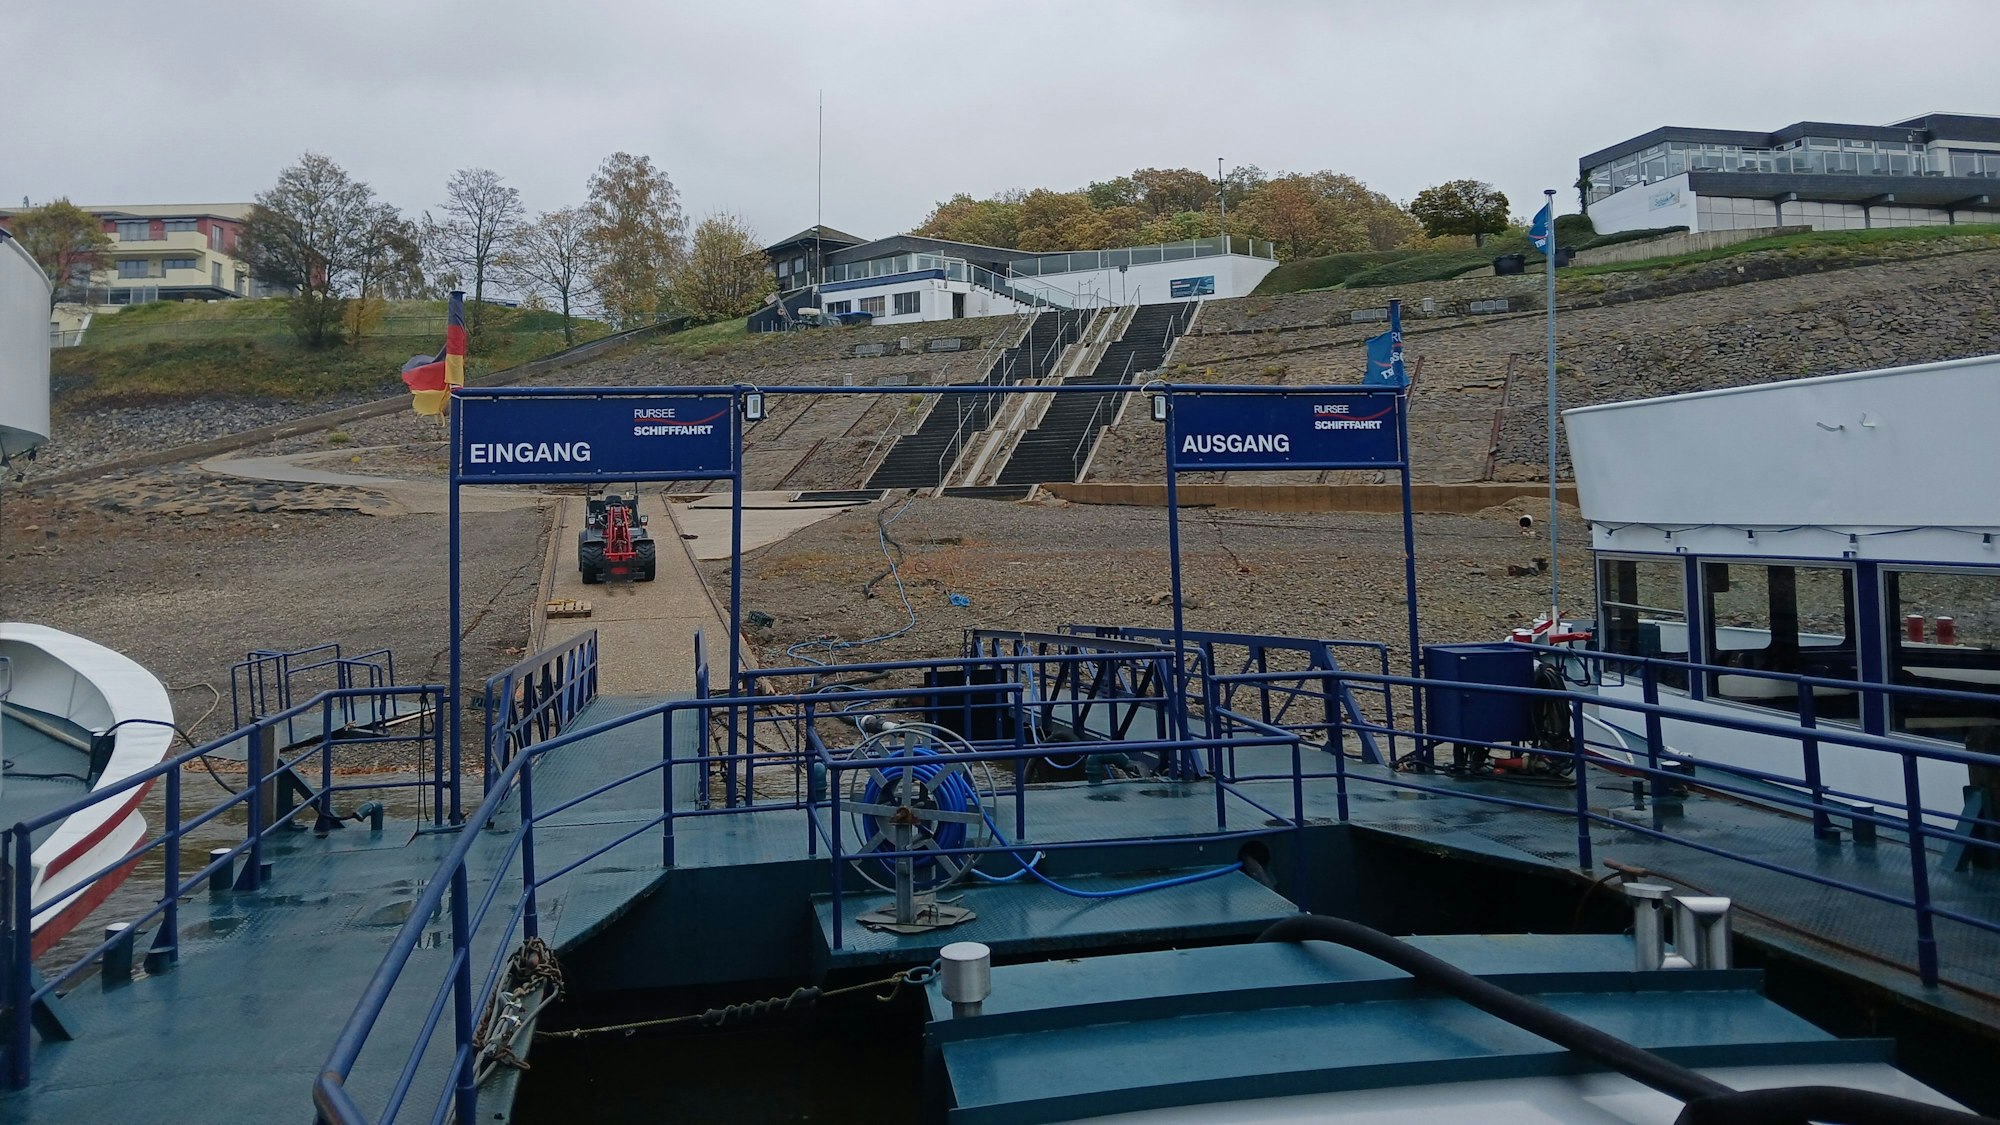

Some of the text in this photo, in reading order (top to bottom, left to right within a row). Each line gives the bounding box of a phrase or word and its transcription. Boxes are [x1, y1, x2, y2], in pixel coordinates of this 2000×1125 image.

[634, 408, 675, 419] RURSEE
[1314, 404, 1350, 414] RURSEE
[634, 425, 713, 436] SCHIFFFAHRT
[1314, 420, 1382, 430] SCHIFFFAHRT
[1182, 434, 1290, 453] AUSGANG
[470, 442, 591, 463] EINGANG
